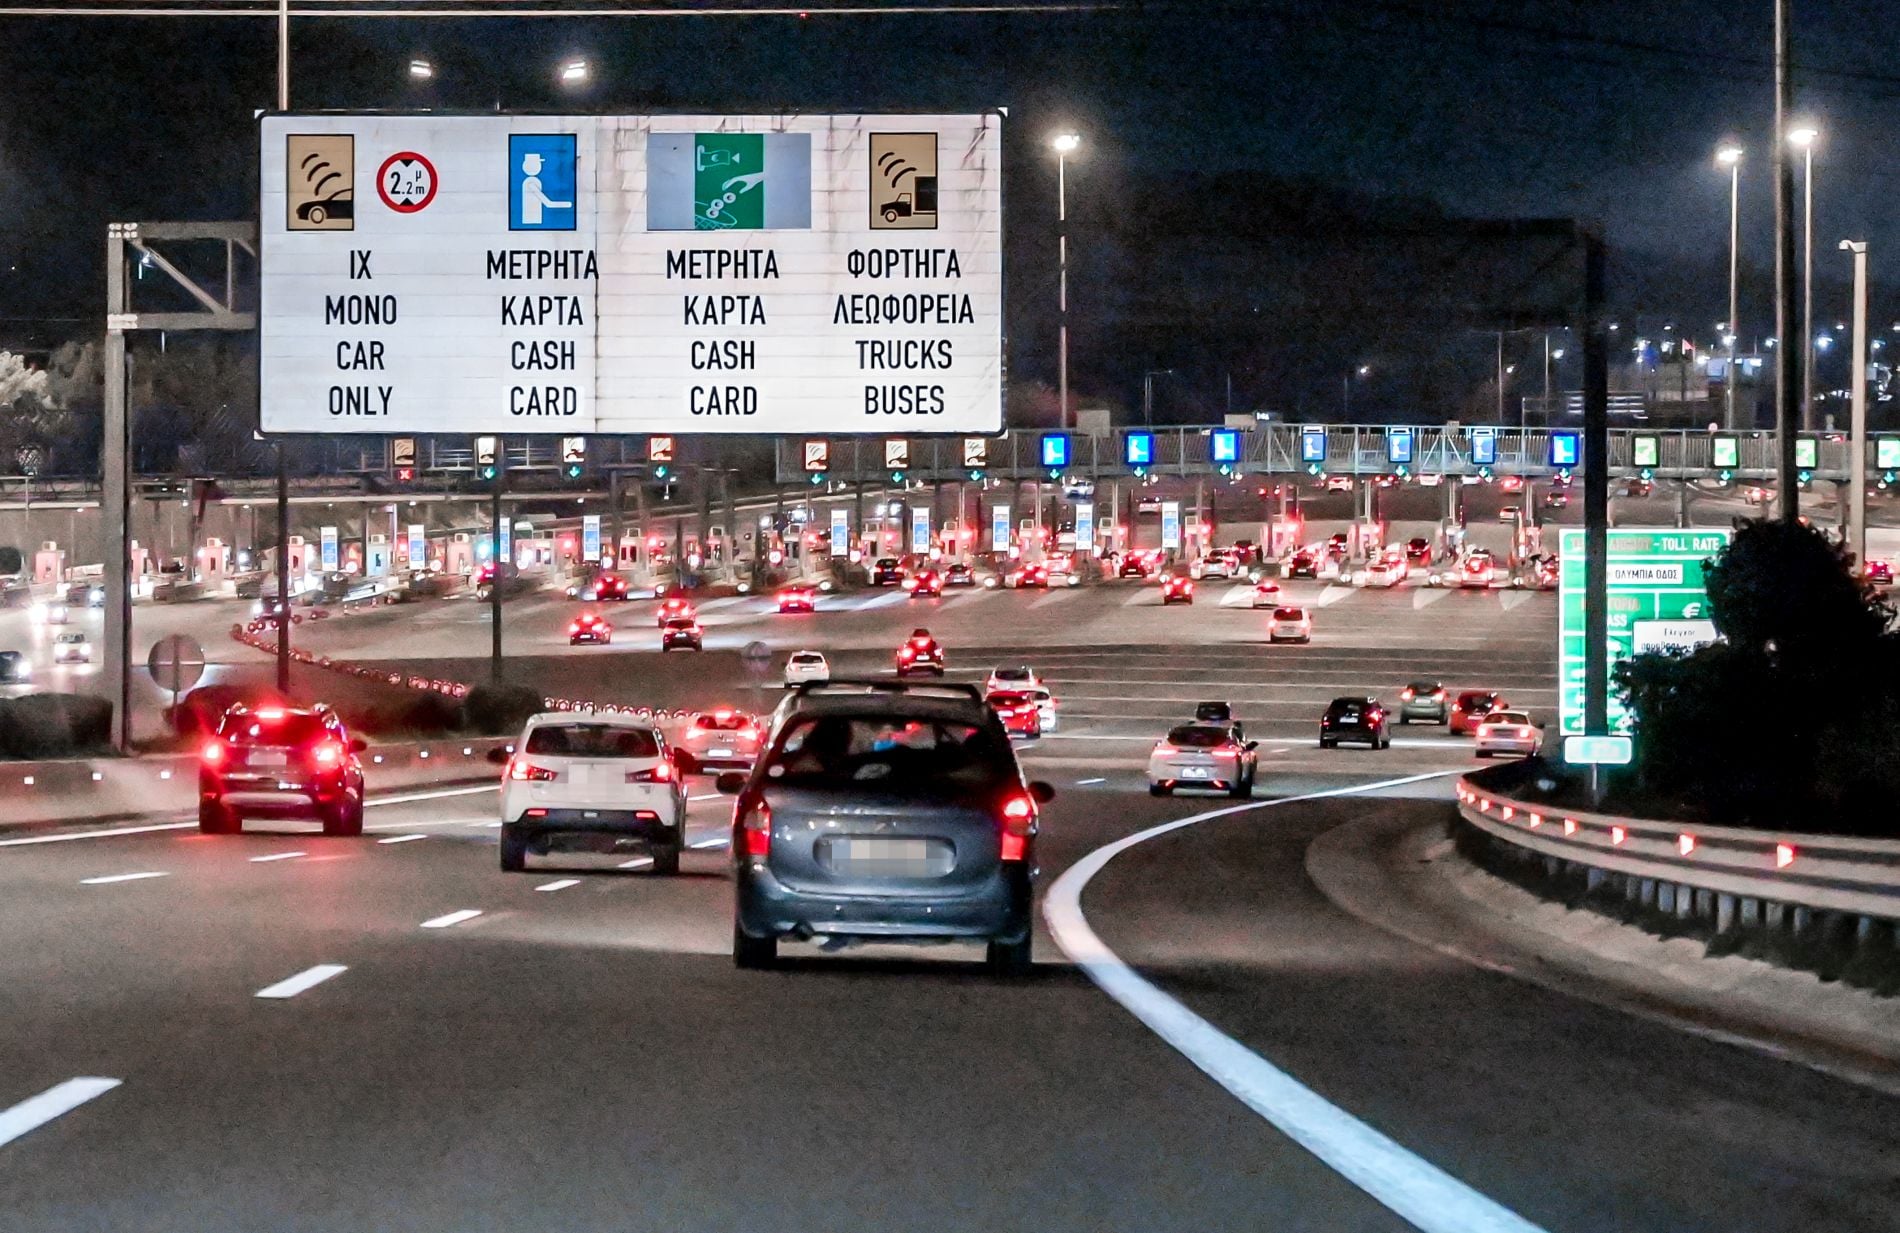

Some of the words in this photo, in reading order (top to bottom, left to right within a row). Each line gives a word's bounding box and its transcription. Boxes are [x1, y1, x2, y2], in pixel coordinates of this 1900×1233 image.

[350, 250, 372, 280] ΙΧ
[486, 250, 599, 280] ΜΕΤΡΗΤΑ
[666, 249, 780, 280] ΜΕΤΡΗΤΑ
[847, 249, 961, 279] ΦΟΡΤΗΓΑ
[325, 295, 397, 325] ΜΟΝΟ
[501, 296, 584, 326] ΚΑΡΤΑ
[684, 296, 766, 325] ΚΑΡΤΑ
[833, 294, 975, 324] ΛΕΩΦΟΡΕΙΑ
[336, 341, 385, 370] CAR
[511, 341, 575, 370] CASH
[691, 341, 755, 370] CASH
[855, 340, 953, 370] TRUCKS
[329, 386, 393, 416] ONLY
[510, 387, 577, 416] CARD
[690, 386, 757, 416] CARD
[865, 385, 944, 415] BUSES
[1661, 537, 1688, 551] TOLL
[1692, 537, 1720, 551] RATE
